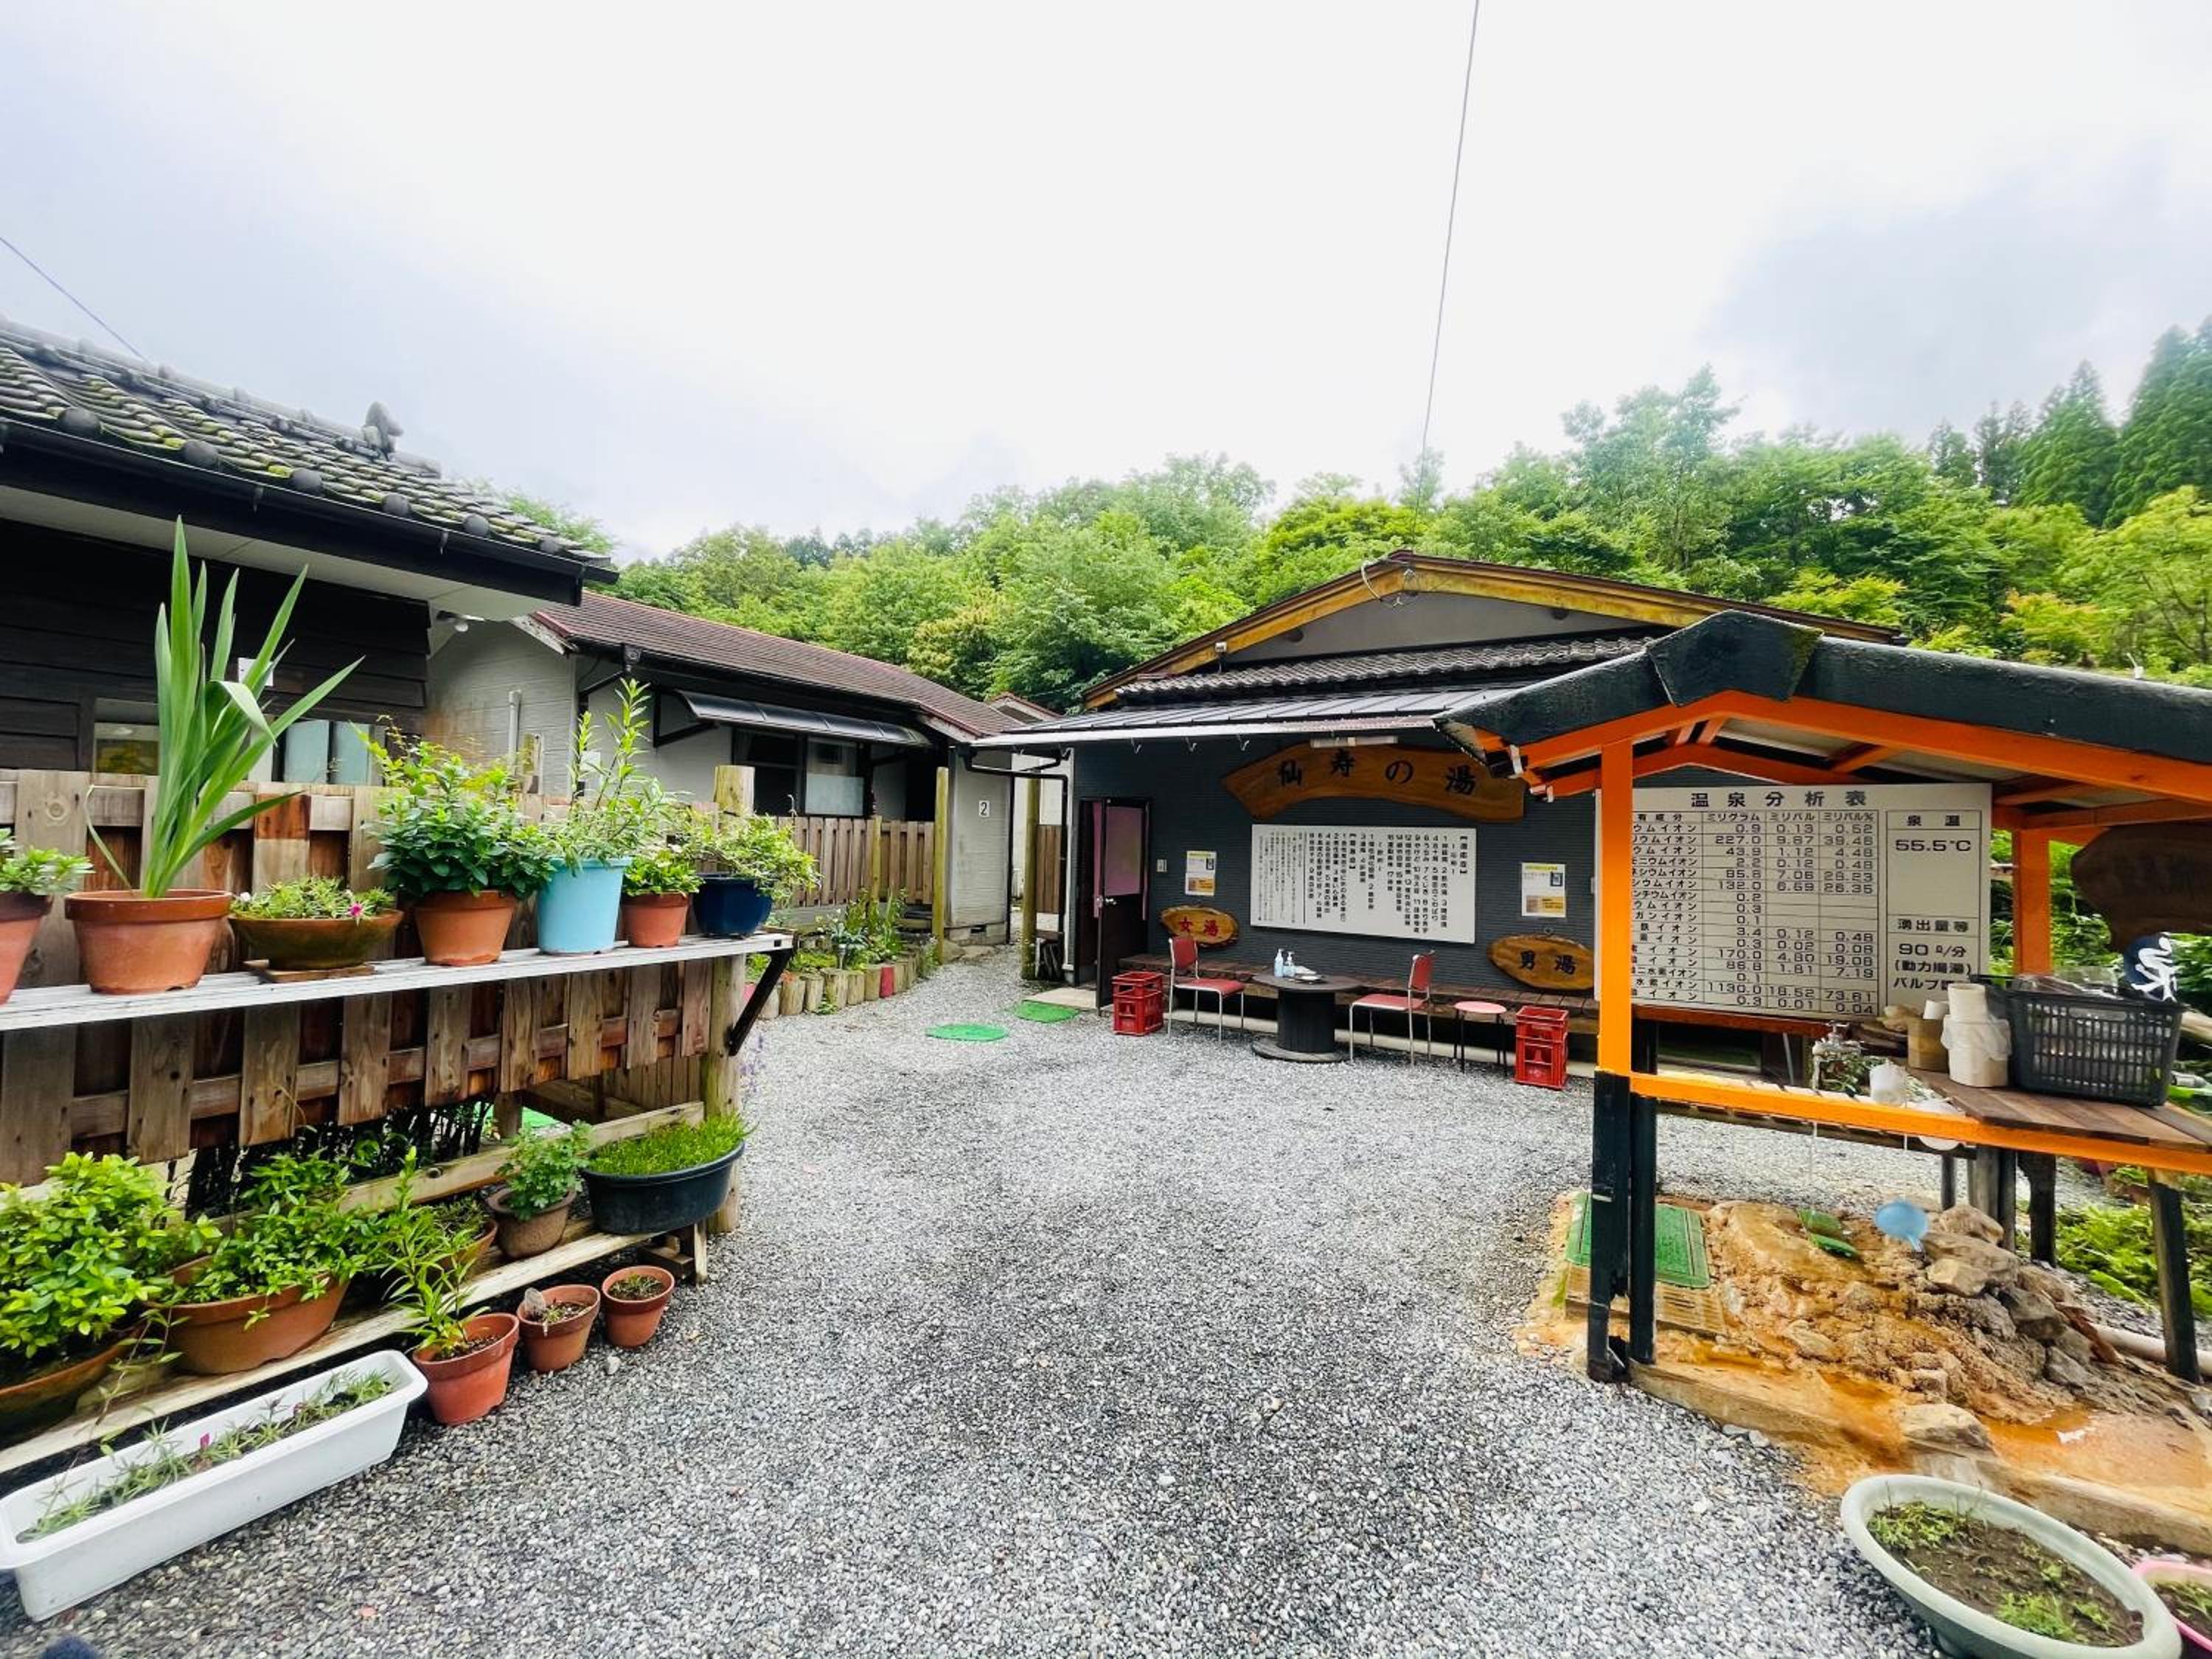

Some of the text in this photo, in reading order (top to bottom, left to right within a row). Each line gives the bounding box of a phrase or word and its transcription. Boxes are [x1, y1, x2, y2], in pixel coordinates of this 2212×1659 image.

[1278, 748, 1477, 796] 仙寿の湯
[1691, 790, 1867, 807] 温泉分析表
[980, 801, 987, 815] 2
[1708, 813, 1760, 822] ミリグラム
[1770, 813, 1815, 821] ミリバル
[1907, 815, 1960, 827] 泉温
[1736, 824, 1761, 834] 0.9
[1776, 824, 1814, 834] 0.13
[1715, 835, 1761, 844] 227.0
[1726, 848, 1761, 856] 43.9
[1779, 848, 1813, 857] 1.12
[1736, 858, 1761, 868] 2.2
[1777, 859, 1813, 868] 0.12
[1719, 880, 1761, 890] 132.0
[1736, 893, 1761, 902] 0.2
[1736, 904, 1761, 914] 0.3
[1736, 915, 1760, 925] 0.1
[1179, 916, 1219, 936] 女湯
[1736, 927, 1761, 936] 3.4
[1777, 928, 1814, 939] 0.12
[1736, 939, 1761, 949] 0.3
[1778, 940, 1815, 950] 0.02
[1899, 943, 1929, 956] 90
[1719, 949, 1761, 959] 170.0
[1520, 950, 1576, 975] 男湯
[1736, 973, 1760, 983] 0.1
[1708, 982, 1762, 994] 1130.0
[1736, 995, 1761, 1006] 0.3
[1778, 999, 1813, 1009] 0.01
[1835, 1003, 1874, 1014] 0.04
